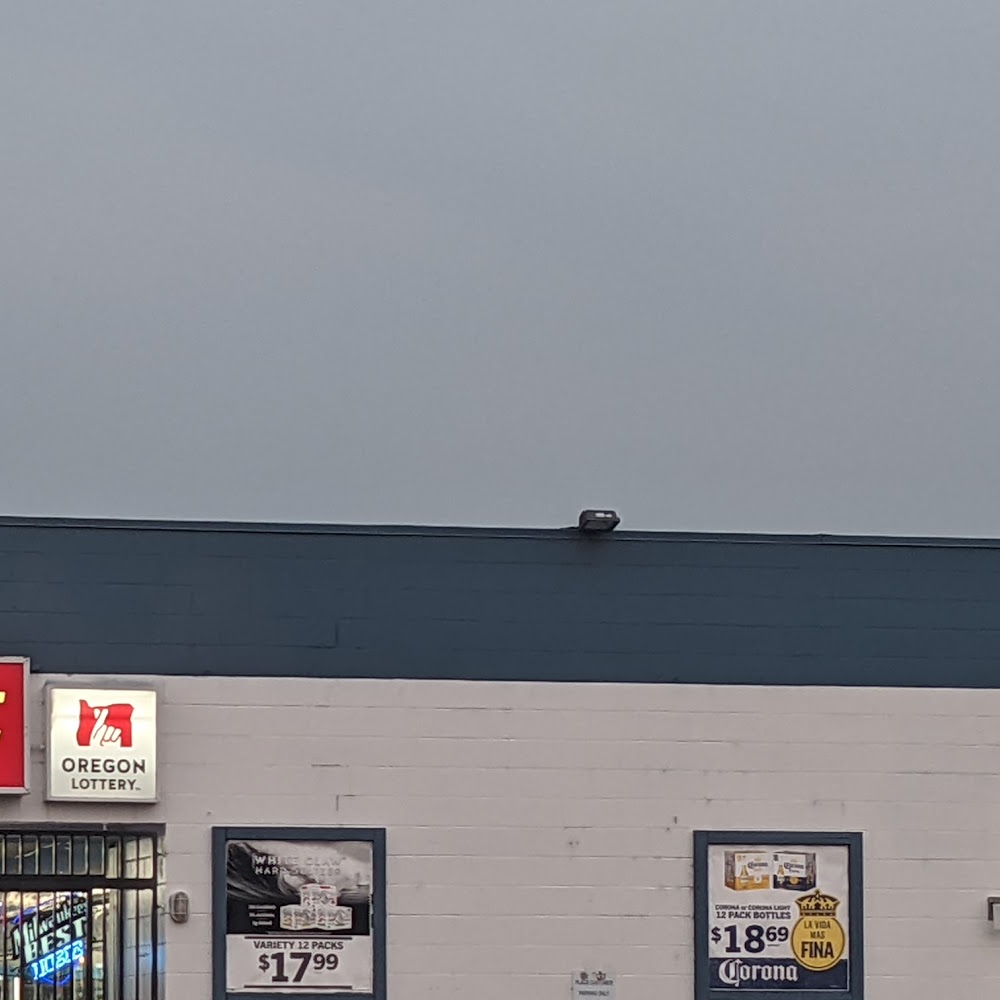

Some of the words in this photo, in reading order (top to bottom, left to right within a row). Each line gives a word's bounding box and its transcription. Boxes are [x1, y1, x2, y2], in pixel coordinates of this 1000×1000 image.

[62, 757, 146, 774] OREGON
[716, 911, 726, 919] 12
[728, 911, 751, 919] PACK
[753, 911, 791, 920] BOTTLES
[804, 920, 813, 929] LA
[815, 920, 831, 929] VIDA
[24, 916, 88, 965] BEST
[253, 940, 295, 950] VARIETY
[298, 940, 309, 950] 12
[311, 940, 344, 950] PACKS
[801, 940, 835, 959] FINA
[718, 957, 799, 987] Corona
